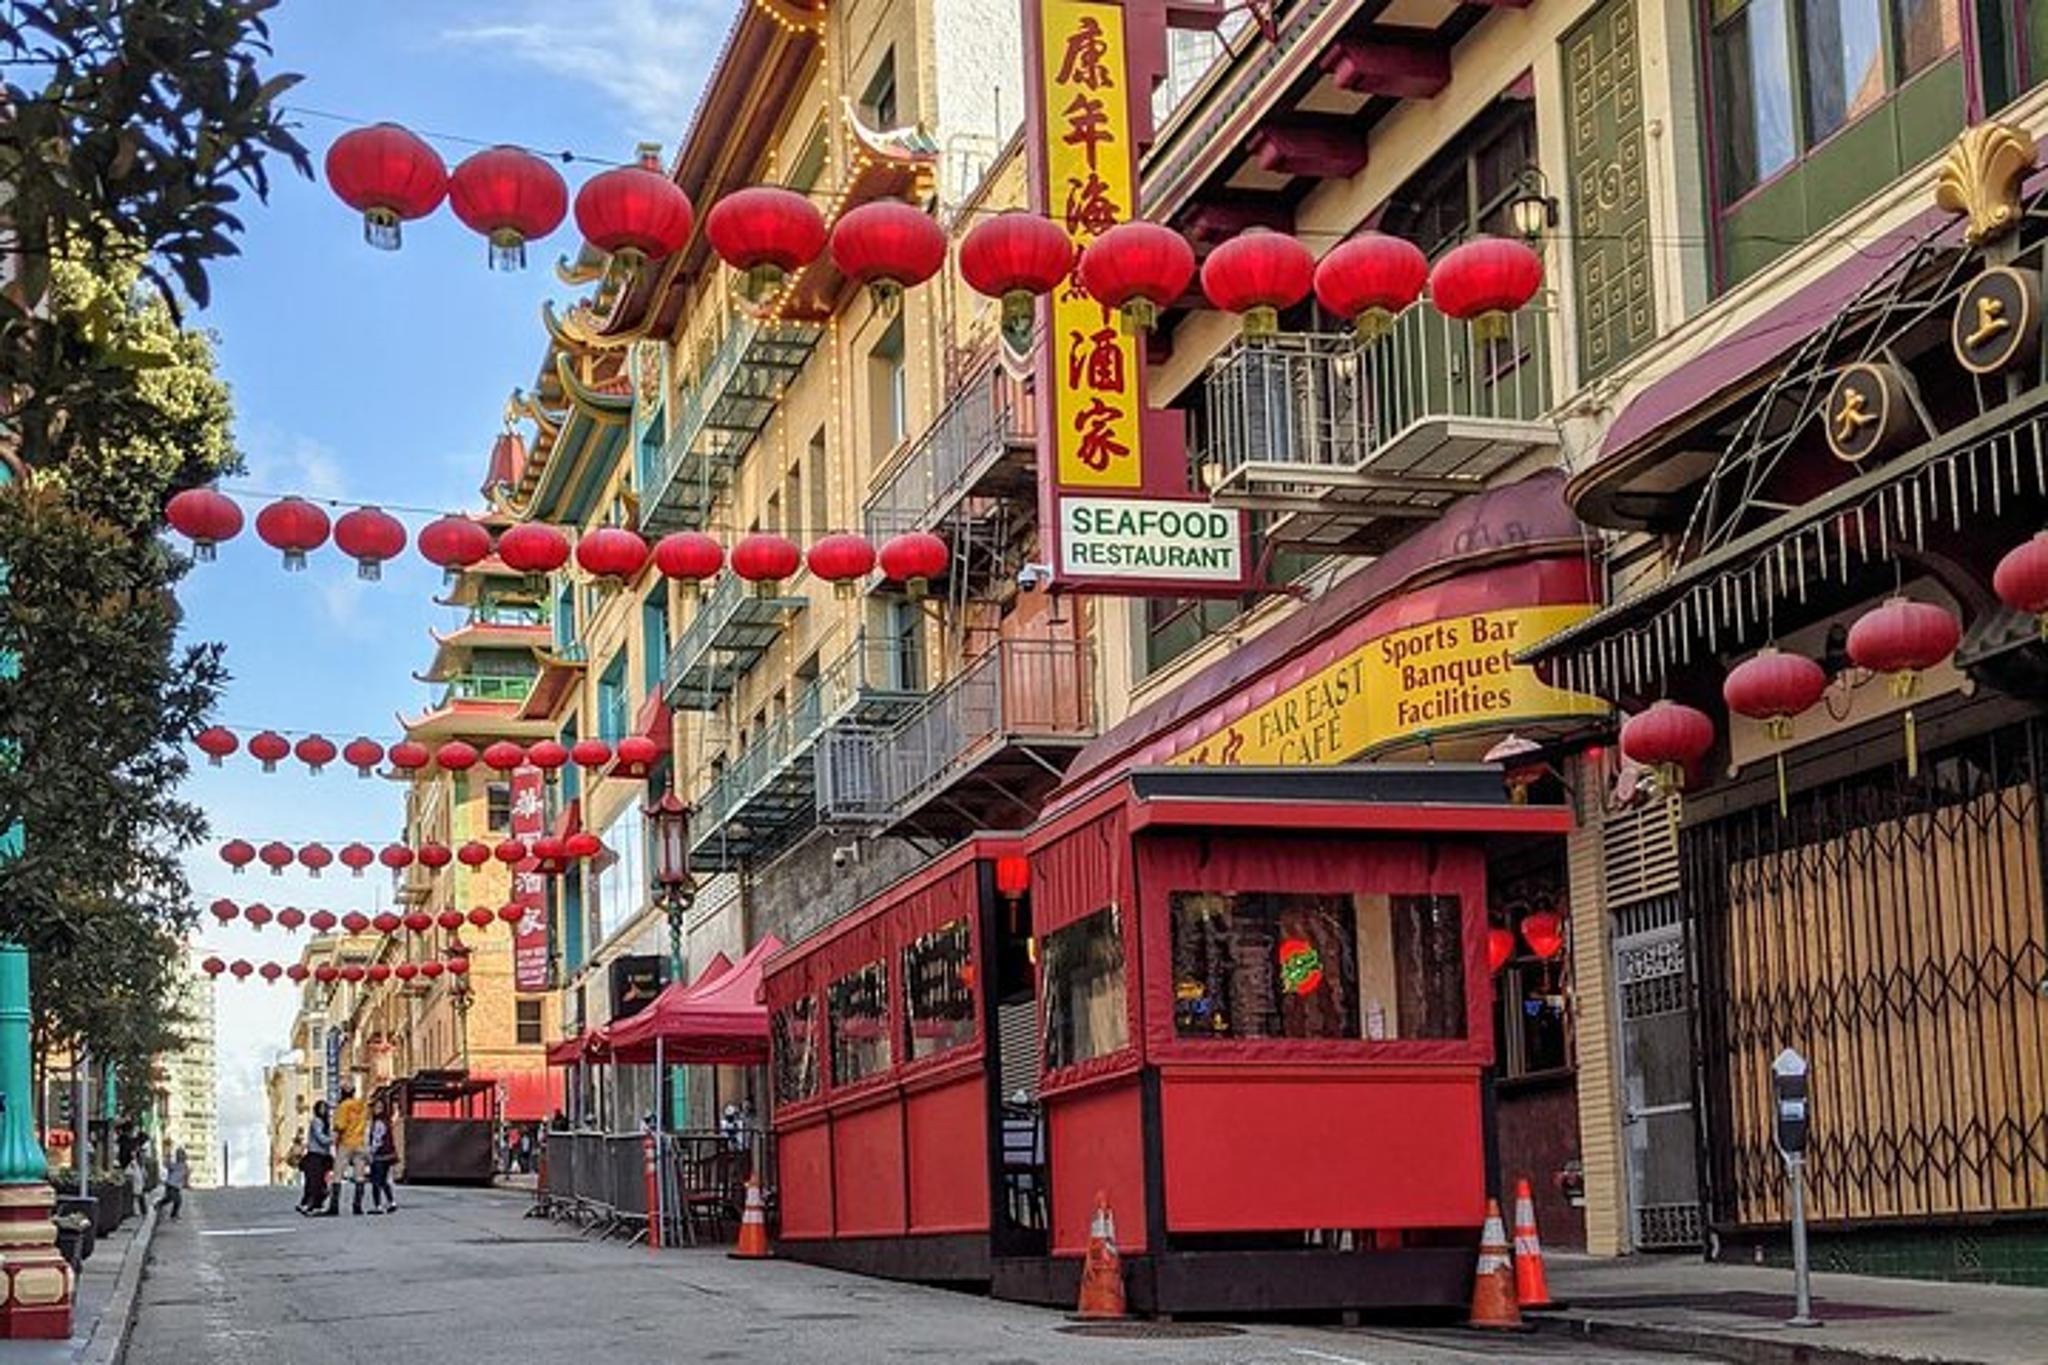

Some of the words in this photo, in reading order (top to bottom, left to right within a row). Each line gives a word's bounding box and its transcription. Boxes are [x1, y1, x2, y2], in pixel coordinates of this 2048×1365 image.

[1071, 507, 1230, 540] SEAFOOD
[1071, 542, 1232, 569] RESTAURANT
[1381, 624, 1458, 669] Sports
[1471, 615, 1519, 644] Bar
[1401, 647, 1513, 692] Banquet
[1259, 698, 1300, 748] FAR
[1304, 656, 1364, 723] EAST
[1397, 683, 1512, 727] Facilities
